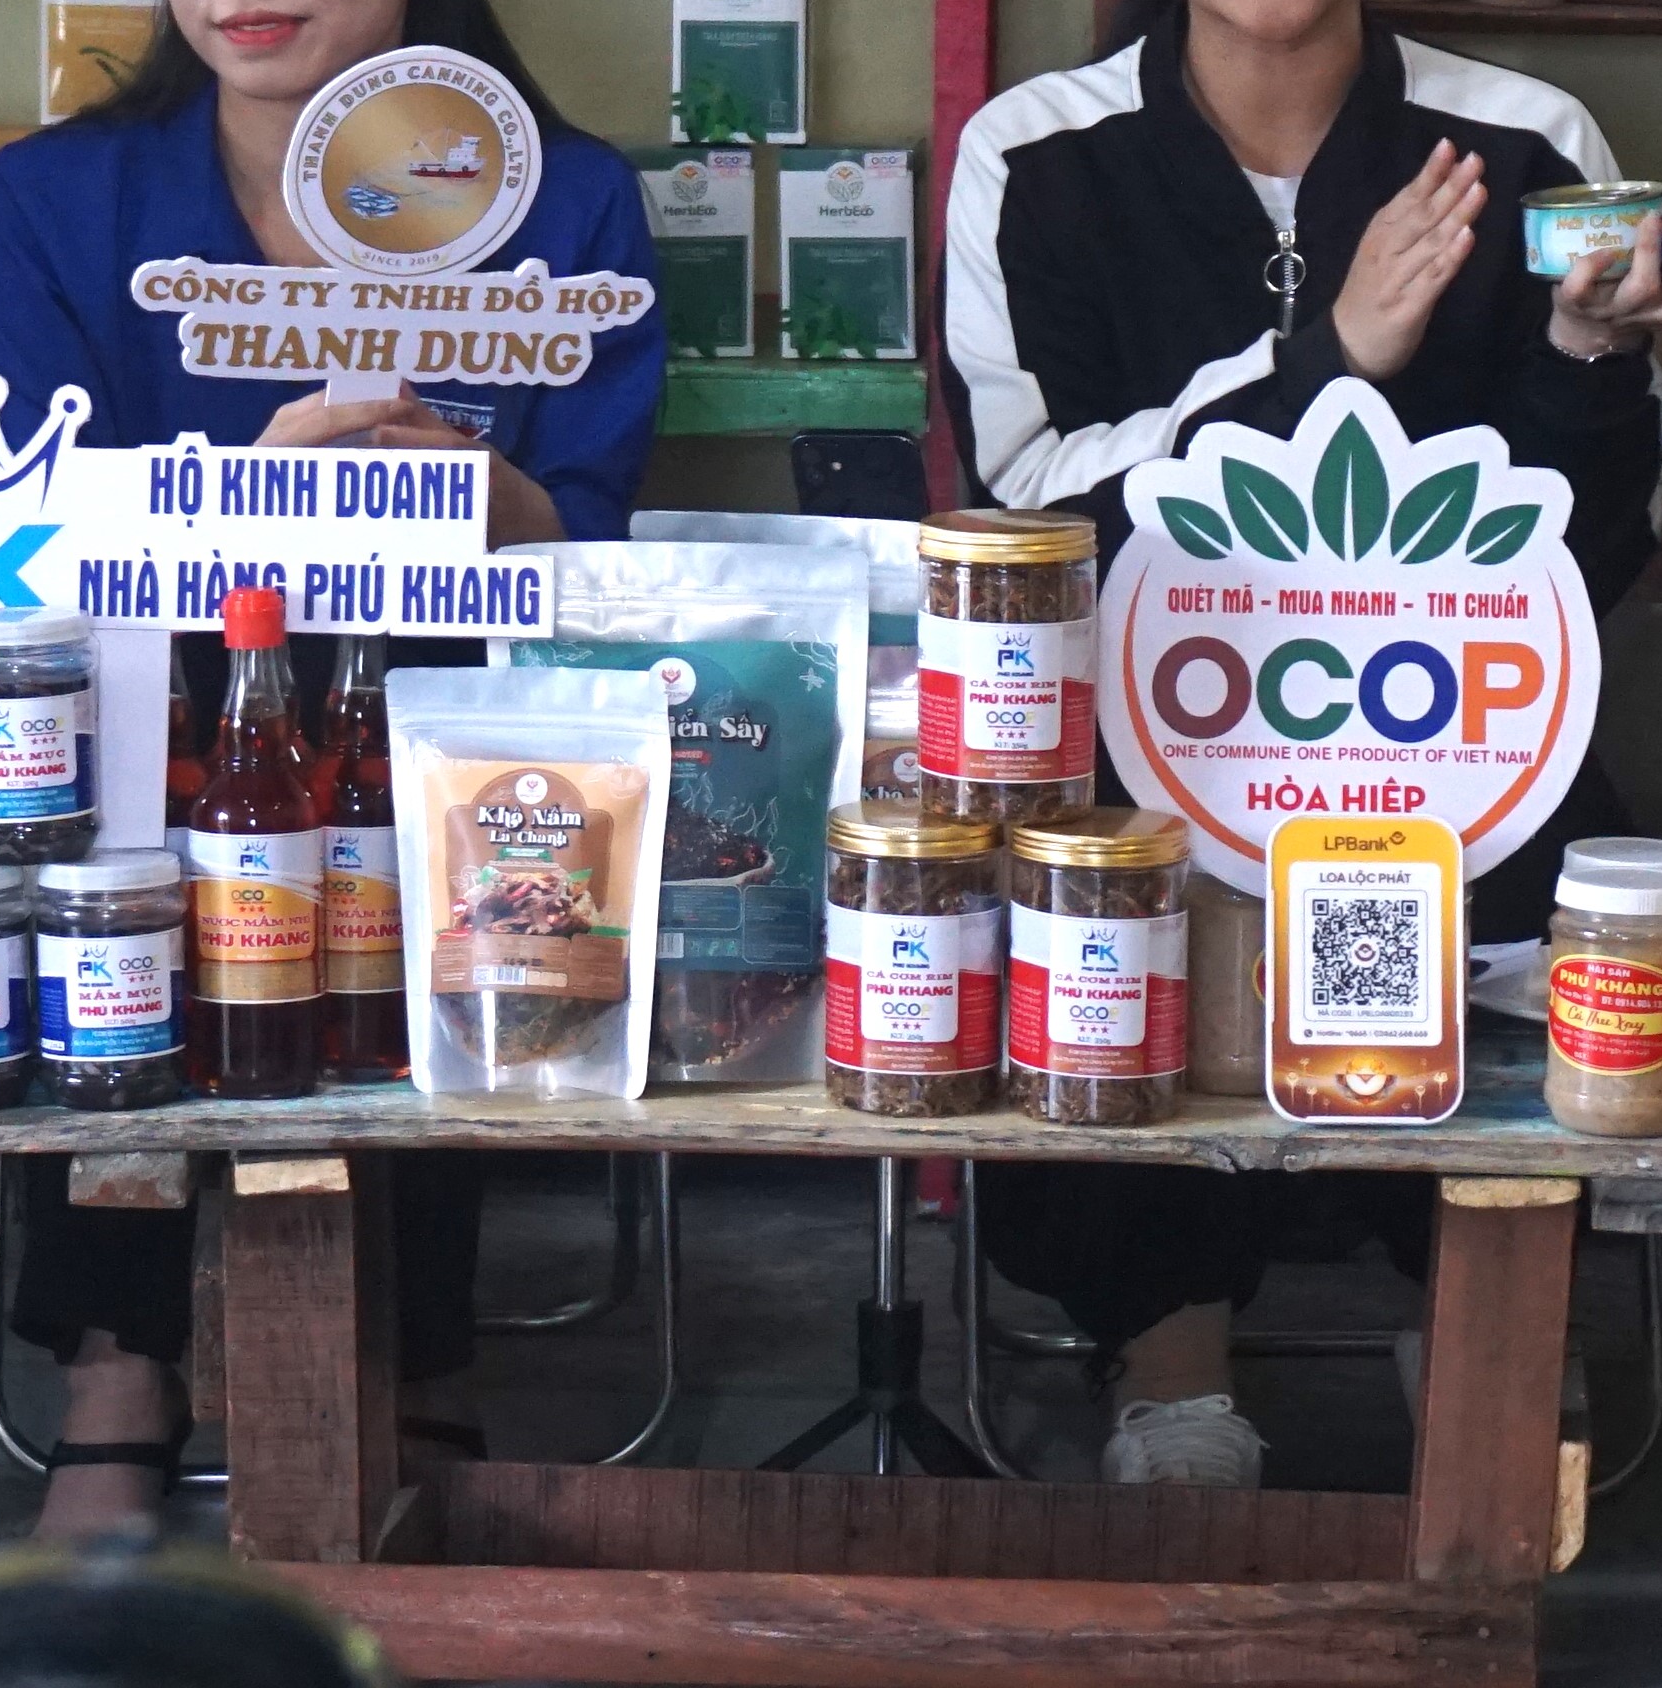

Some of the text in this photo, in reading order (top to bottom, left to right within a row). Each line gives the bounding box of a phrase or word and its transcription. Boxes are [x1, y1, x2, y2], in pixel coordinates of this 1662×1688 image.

[303, 111, 339, 183] THANH
[339, 68, 398, 110] DUNG
[407, 65, 500, 108] CANNING
[362, 249, 442, 267] SINCE 2019
[144, 270, 644, 322] CÔNG TY TNHH ĐỒ HỘP
[192, 322, 583, 375] THANH DUNG
[150, 446, 475, 525] HỘ KINH DOANH
[78, 549, 159, 618] NHÀ
[304, 553, 384, 623] PHÚ
[402, 566, 541, 627] KHANG
[1168, 582, 1530, 620] QUÉT MÃ MUA NHANH TIN CHUẨN
[1152, 636, 1545, 745] OCOP
[669, 708, 708, 737] iển
[1163, 744, 1532, 765] ONE COMMUNE ONE PRODUCT OF VIET NAM
[1248, 774, 1330, 812] HÒA
[1324, 836, 1389, 852] LPBank
[1320, 870, 1412, 886] LOA LỘC PHÁT
